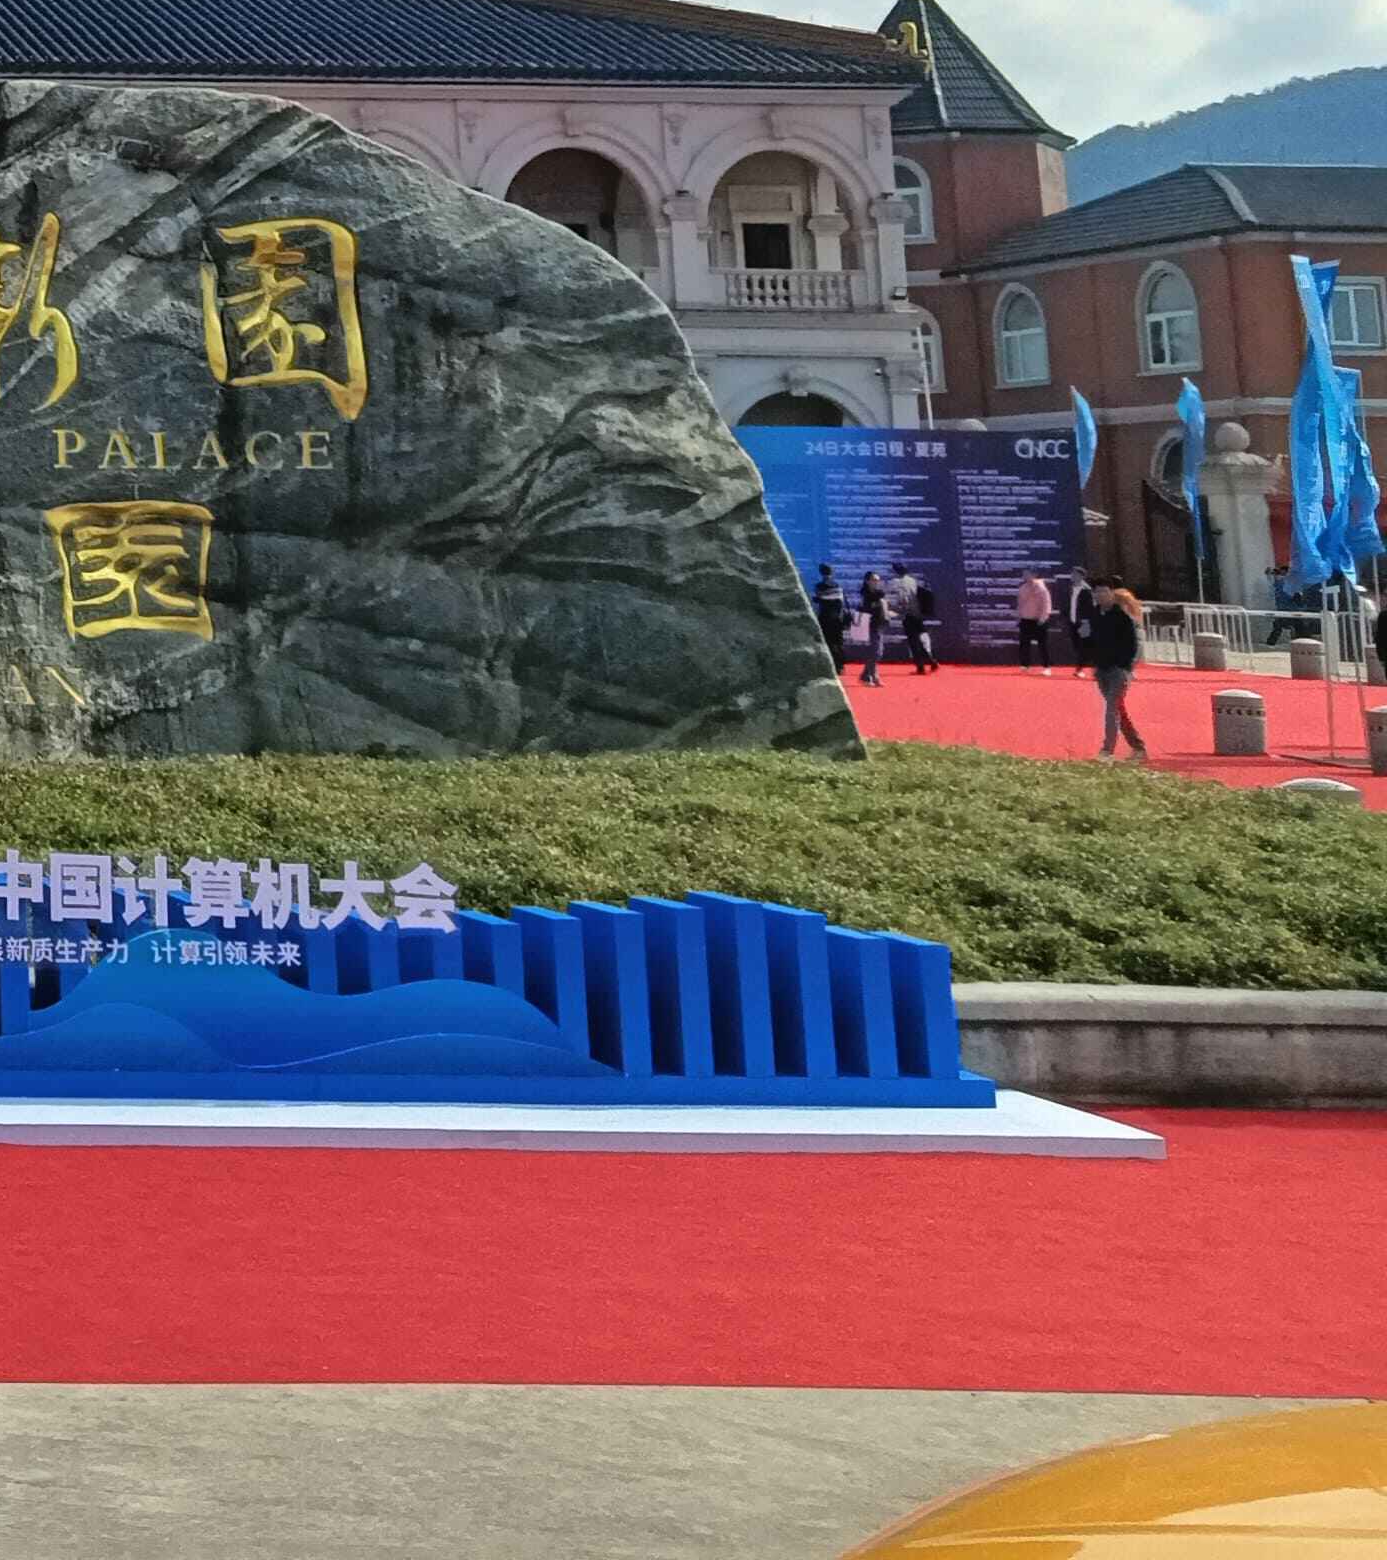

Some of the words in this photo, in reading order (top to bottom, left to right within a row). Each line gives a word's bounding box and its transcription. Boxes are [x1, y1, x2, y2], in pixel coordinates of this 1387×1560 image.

[52, 428, 334, 471] PALACE
[1014, 438, 1071, 459] CNCC
[150, 939, 302, 968] 计算引领未来
